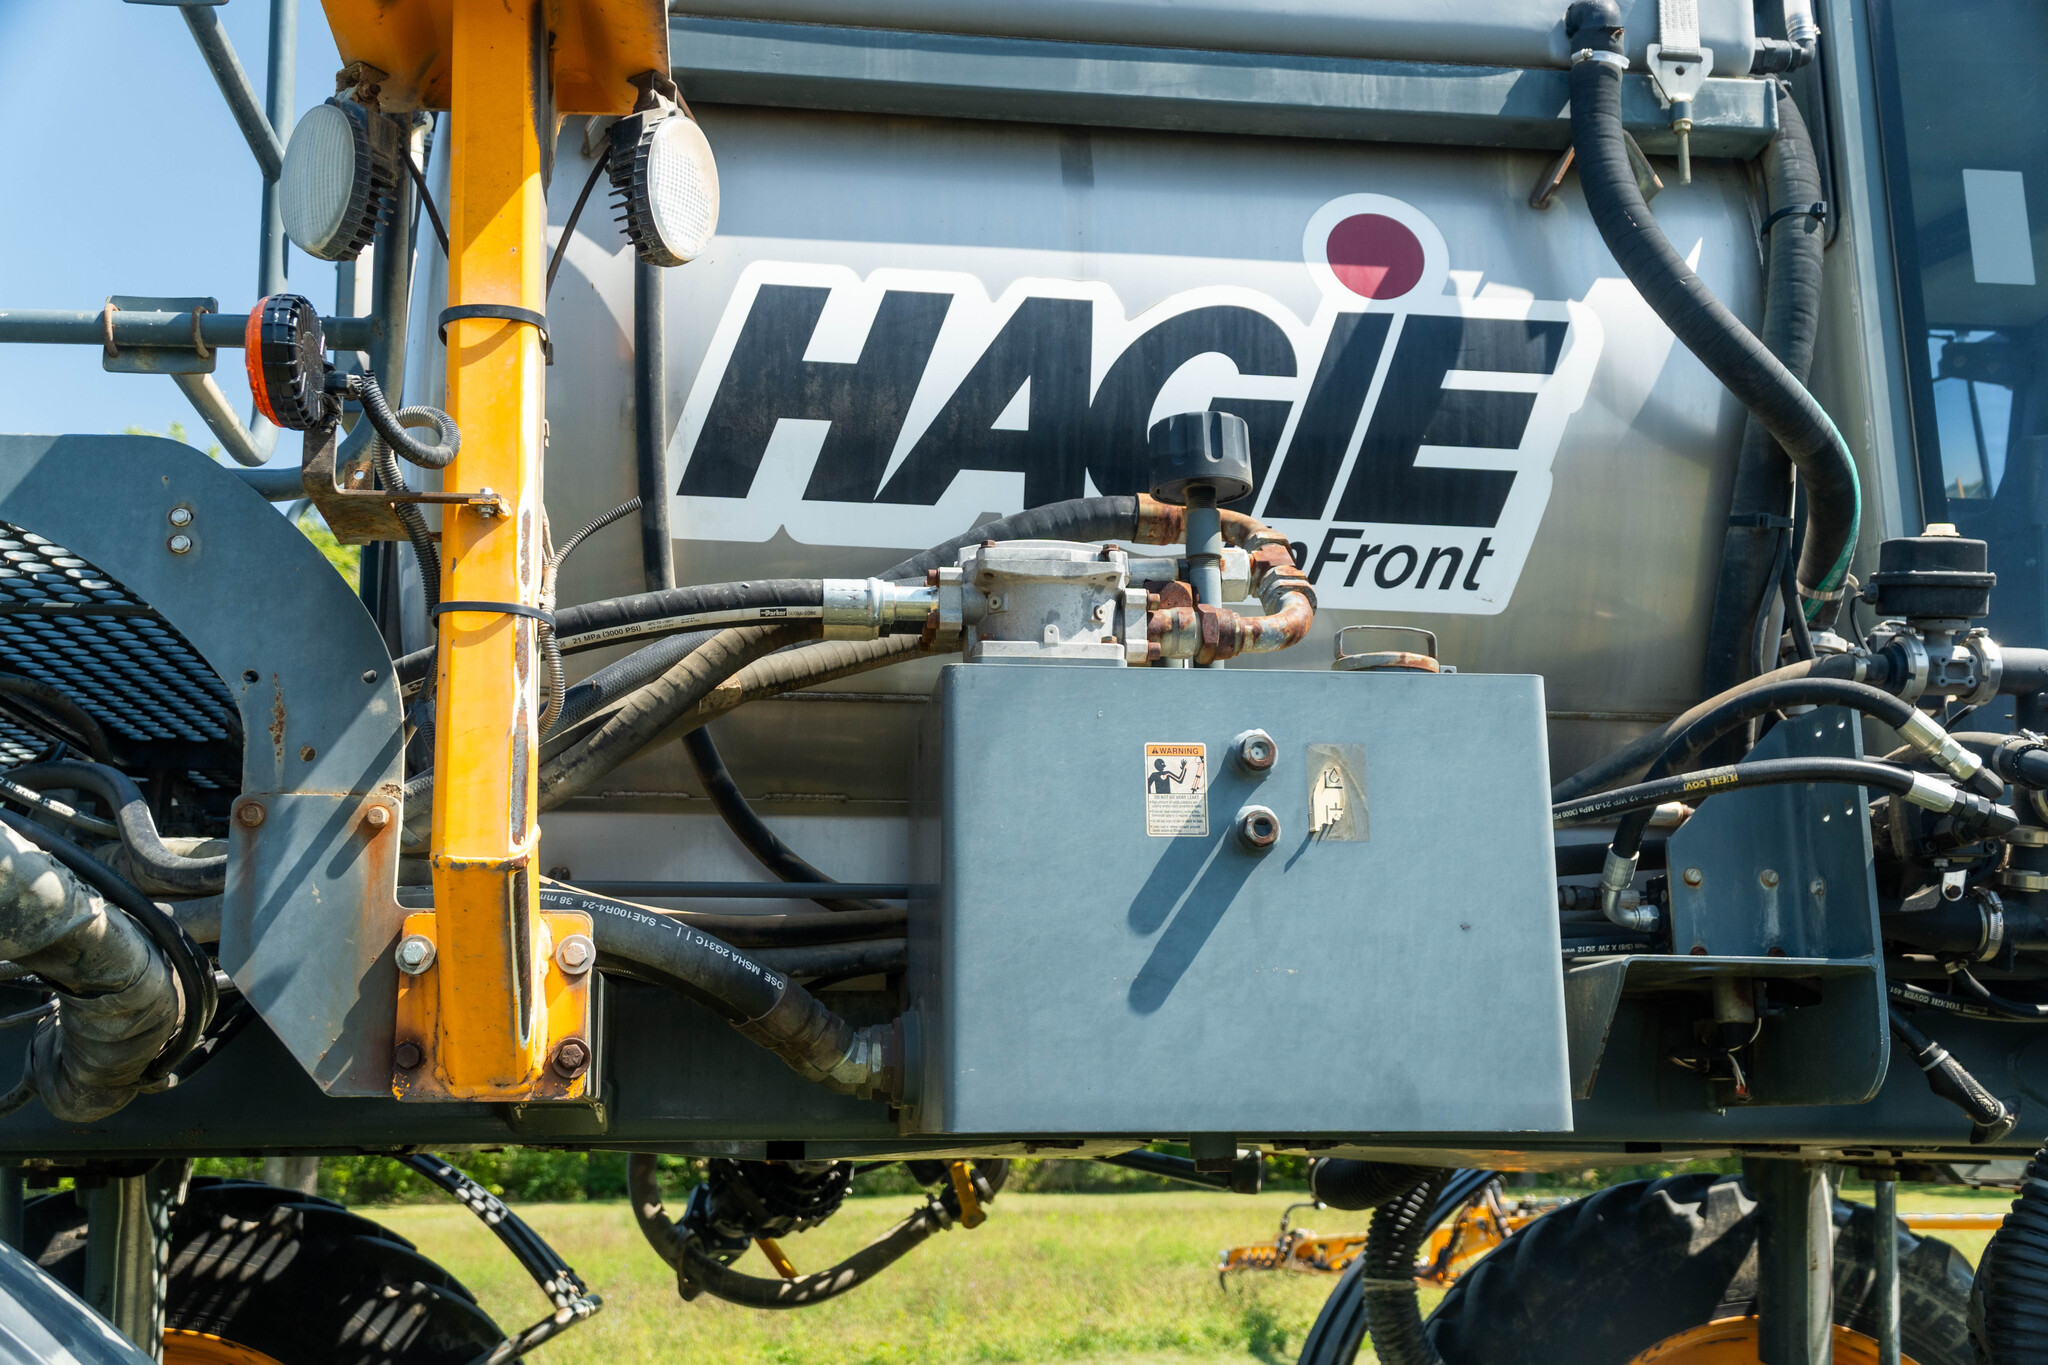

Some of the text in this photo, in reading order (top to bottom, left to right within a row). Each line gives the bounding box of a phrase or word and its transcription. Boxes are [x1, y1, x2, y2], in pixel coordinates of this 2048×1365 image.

[764, 609, 786, 617] Parker
[584, 634, 601, 642] MPa
[602, 629, 624, 639] (3000
[625, 624, 642, 635] PSI)
[1159, 747, 1199, 755] WARNING
[1578, 803, 1595, 814] MPa
[1594, 800, 1612, 810] 21.0
[1562, 807, 1579, 818] (3000
[558, 896, 574, 906] 38
[581, 900, 657, 927] SAE100R4-24
[1577, 945, 1596, 953] 2Q12
[1597, 944, 1610, 952] 2W
[695, 935, 785, 991] OSE MSHA 2G31C
[1902, 990, 1930, 1003] COVER
[1930, 996, 1961, 1011] TOUGH
